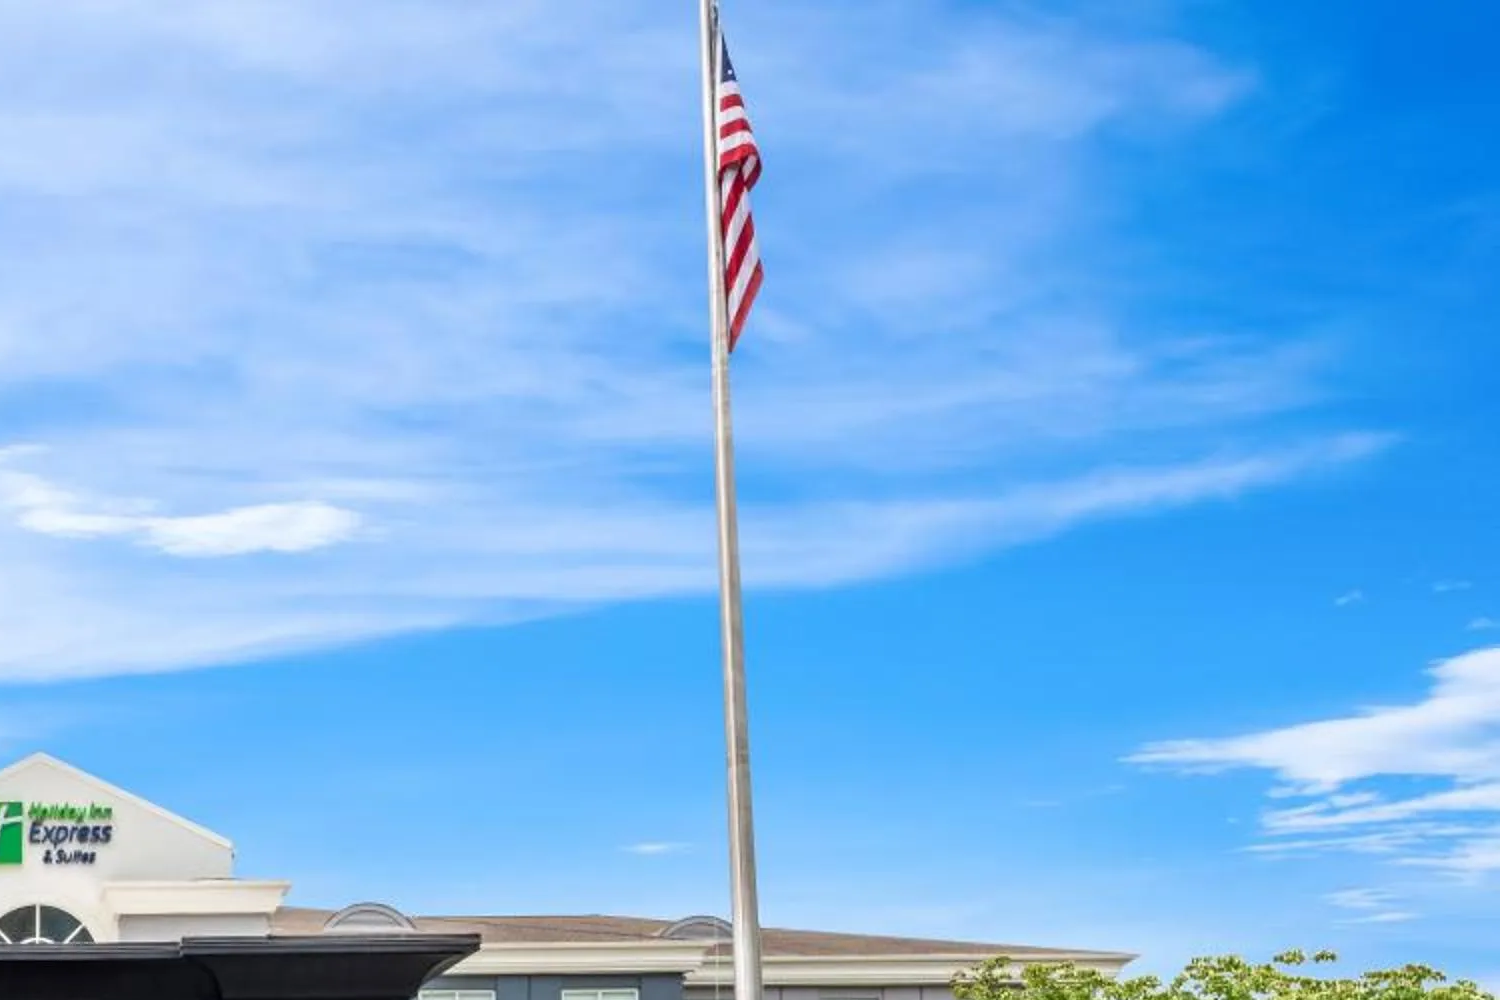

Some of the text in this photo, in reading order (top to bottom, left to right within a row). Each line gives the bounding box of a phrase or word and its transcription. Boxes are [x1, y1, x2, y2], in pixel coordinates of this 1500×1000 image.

[28, 802, 112, 823] Holiday Inn
[29, 822, 112, 849] Express
[43, 849, 96, 864] & Suites
